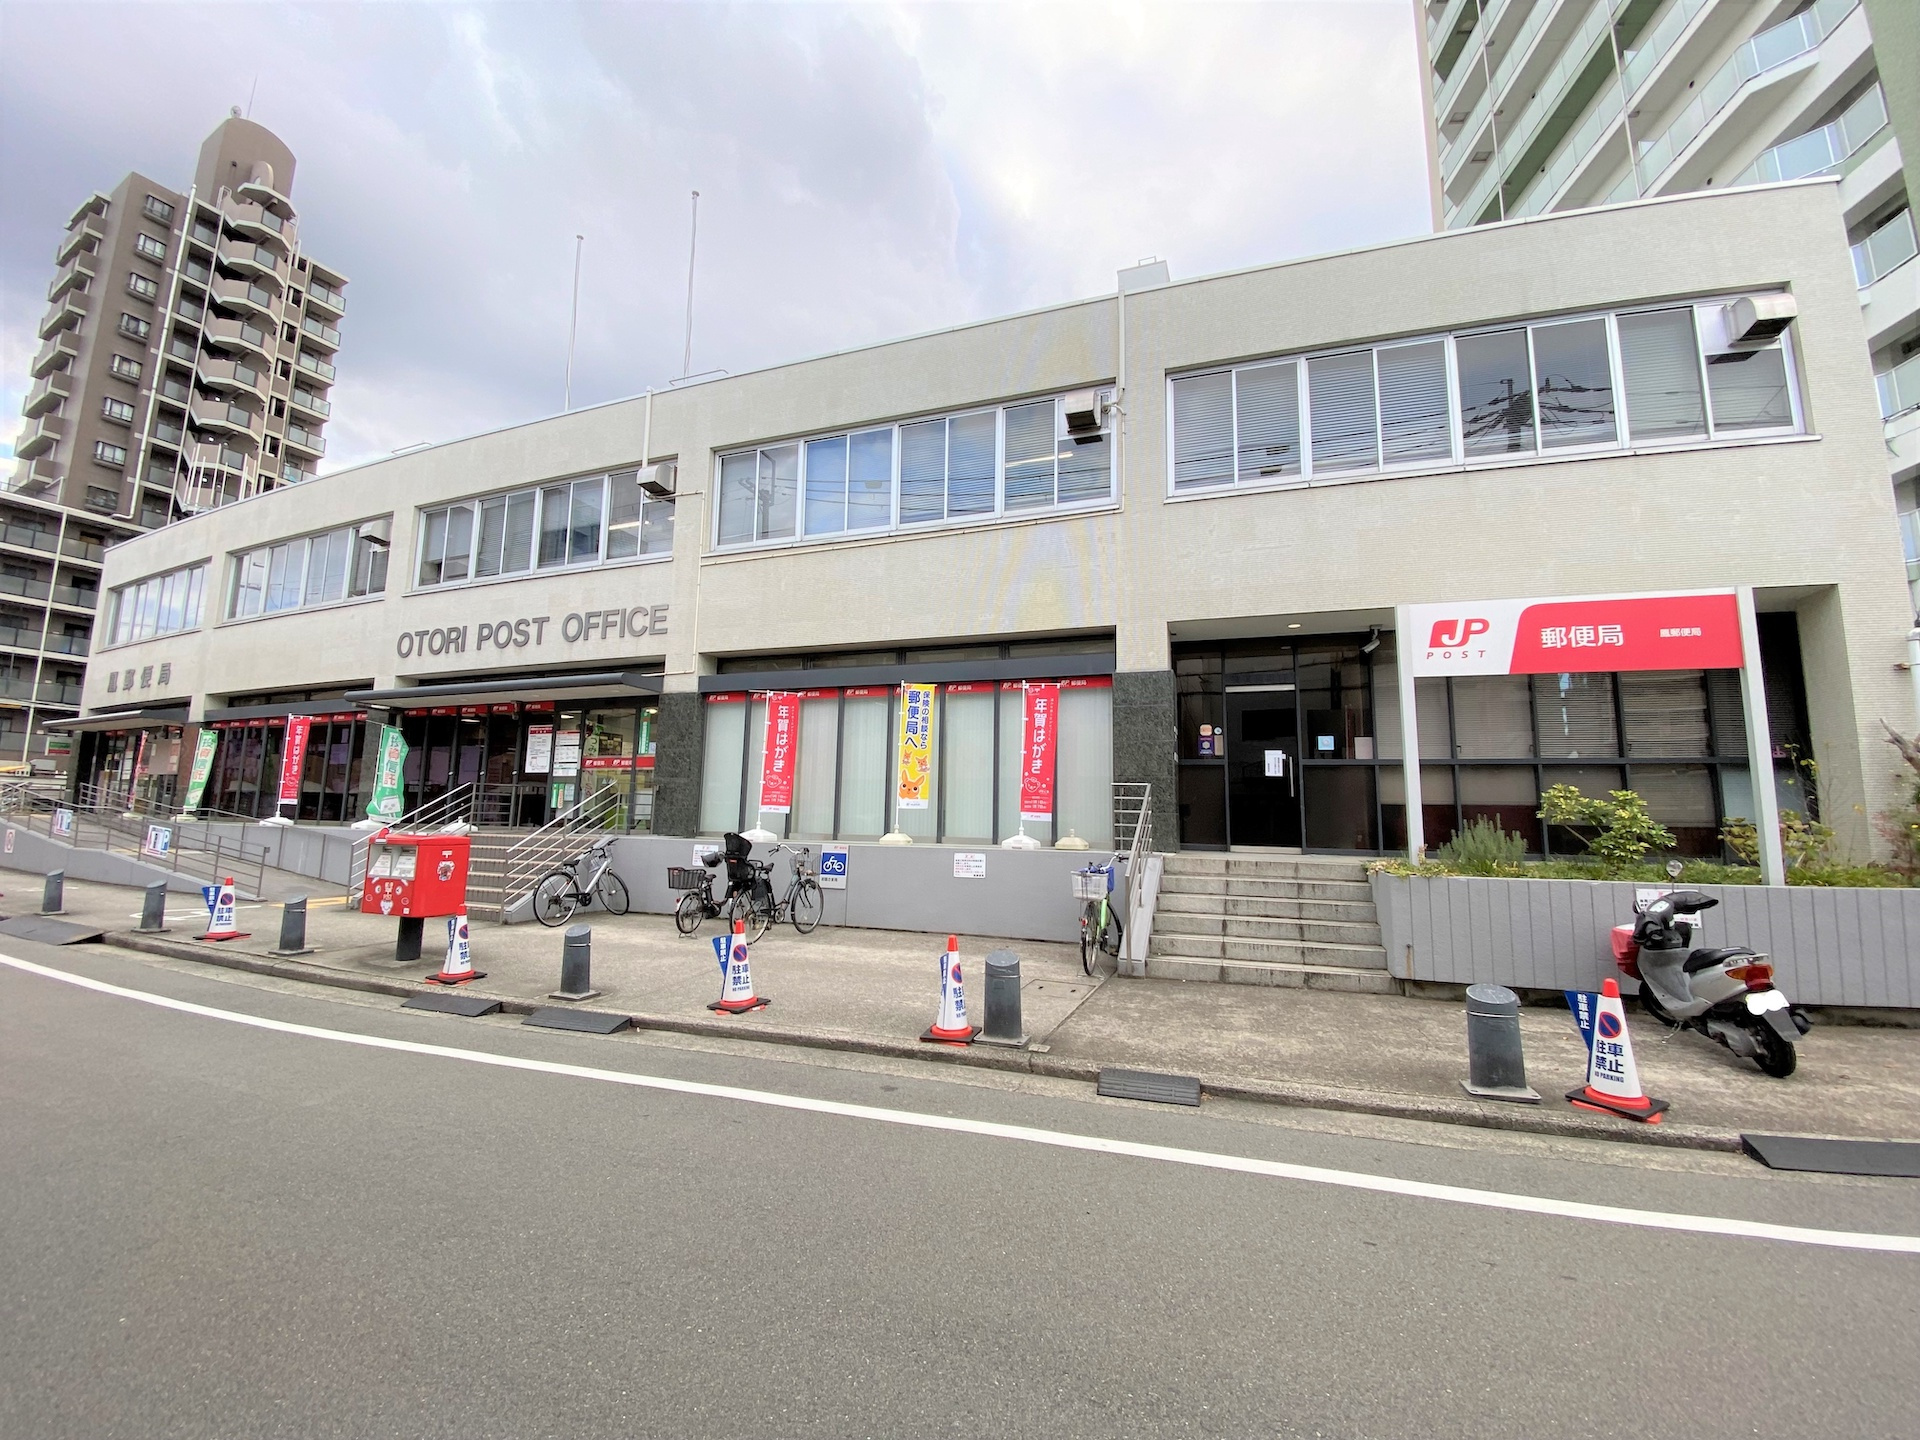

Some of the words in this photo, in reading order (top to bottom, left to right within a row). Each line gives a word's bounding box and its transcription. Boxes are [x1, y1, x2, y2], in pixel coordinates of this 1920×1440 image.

[397, 625, 468, 659] OTORI
[476, 616, 550, 651] POST
[561, 604, 670, 643] OFFICE
[1429, 618, 1490, 648] JP
[1540, 624, 1625, 649] 郵便局
[1426, 650, 1486, 660] POST
[905, 690, 921, 748] 郵便局へ
[773, 704, 789, 773] 年賀はがき
[1031, 698, 1047, 774] 年賀はがき
[732, 963, 749, 975] 駐車
[732, 974, 750, 986] 禁止
[1577, 993, 1590, 1030] 駐車禁止
[1596, 1039, 1624, 1057] 駐車
[1595, 1054, 1625, 1074] 禁止
[1600, 1072, 1625, 1083] PARKING
